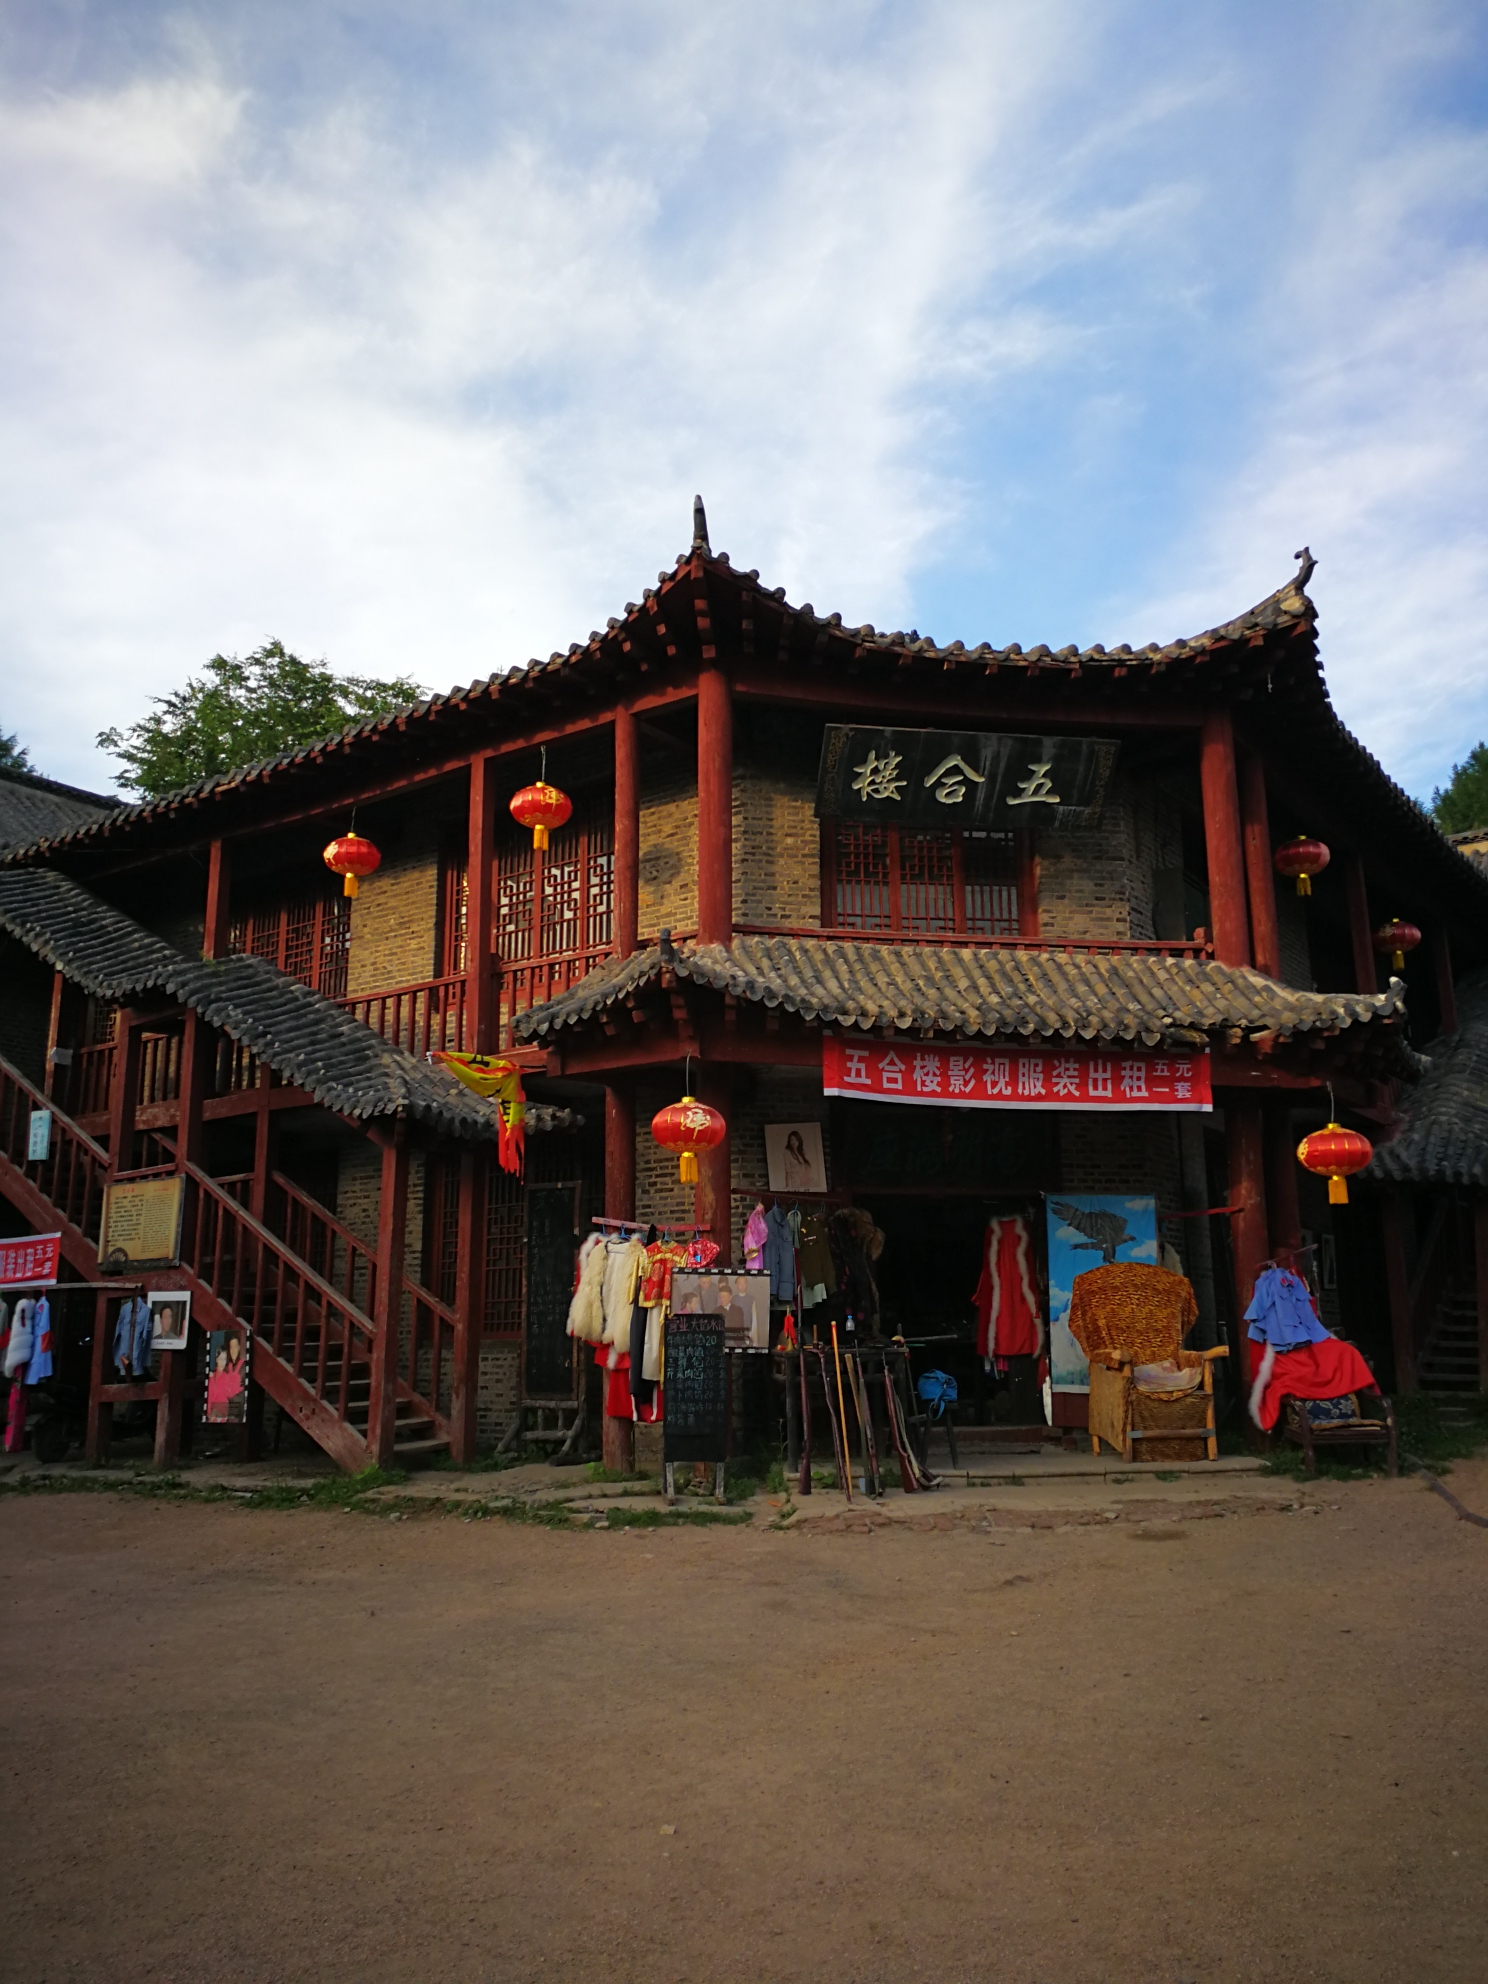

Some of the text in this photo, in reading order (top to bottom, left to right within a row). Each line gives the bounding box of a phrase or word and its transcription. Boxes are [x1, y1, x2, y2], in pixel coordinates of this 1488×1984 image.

[843, 1048, 1149, 1099] 五合楼影视服装出租
[1153, 1059, 1192, 1078] 五元
[1153, 1081, 1192, 1099] 一套
